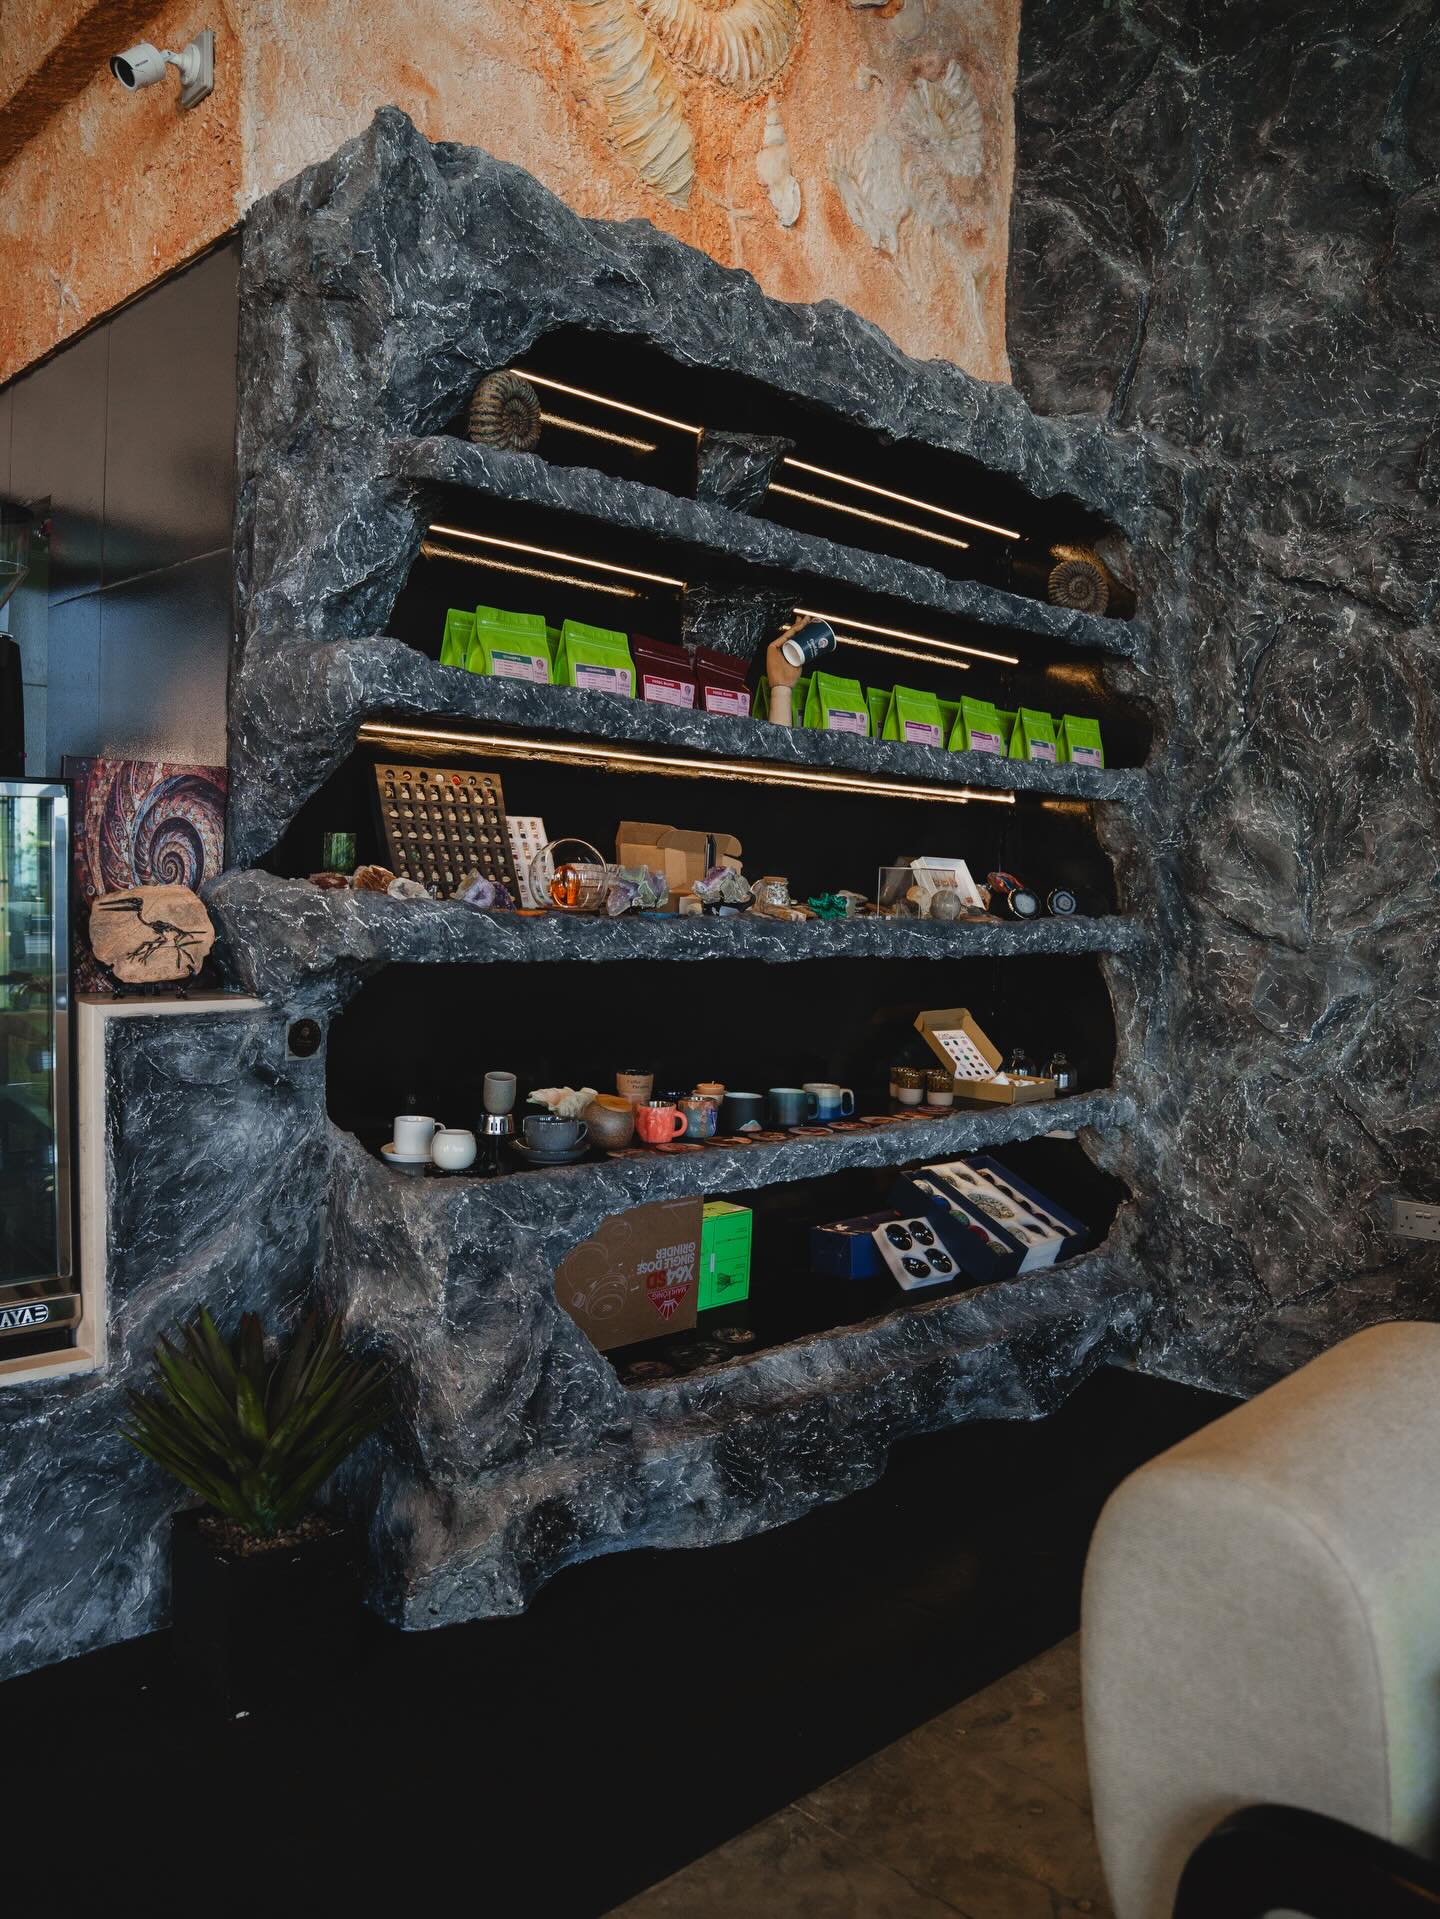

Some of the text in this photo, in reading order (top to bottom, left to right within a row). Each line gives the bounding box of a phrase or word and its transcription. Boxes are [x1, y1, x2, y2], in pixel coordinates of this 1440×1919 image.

[656, 1242, 696, 1260] GRINDER
[636, 1252, 695, 1275] SINGLE DOSE
